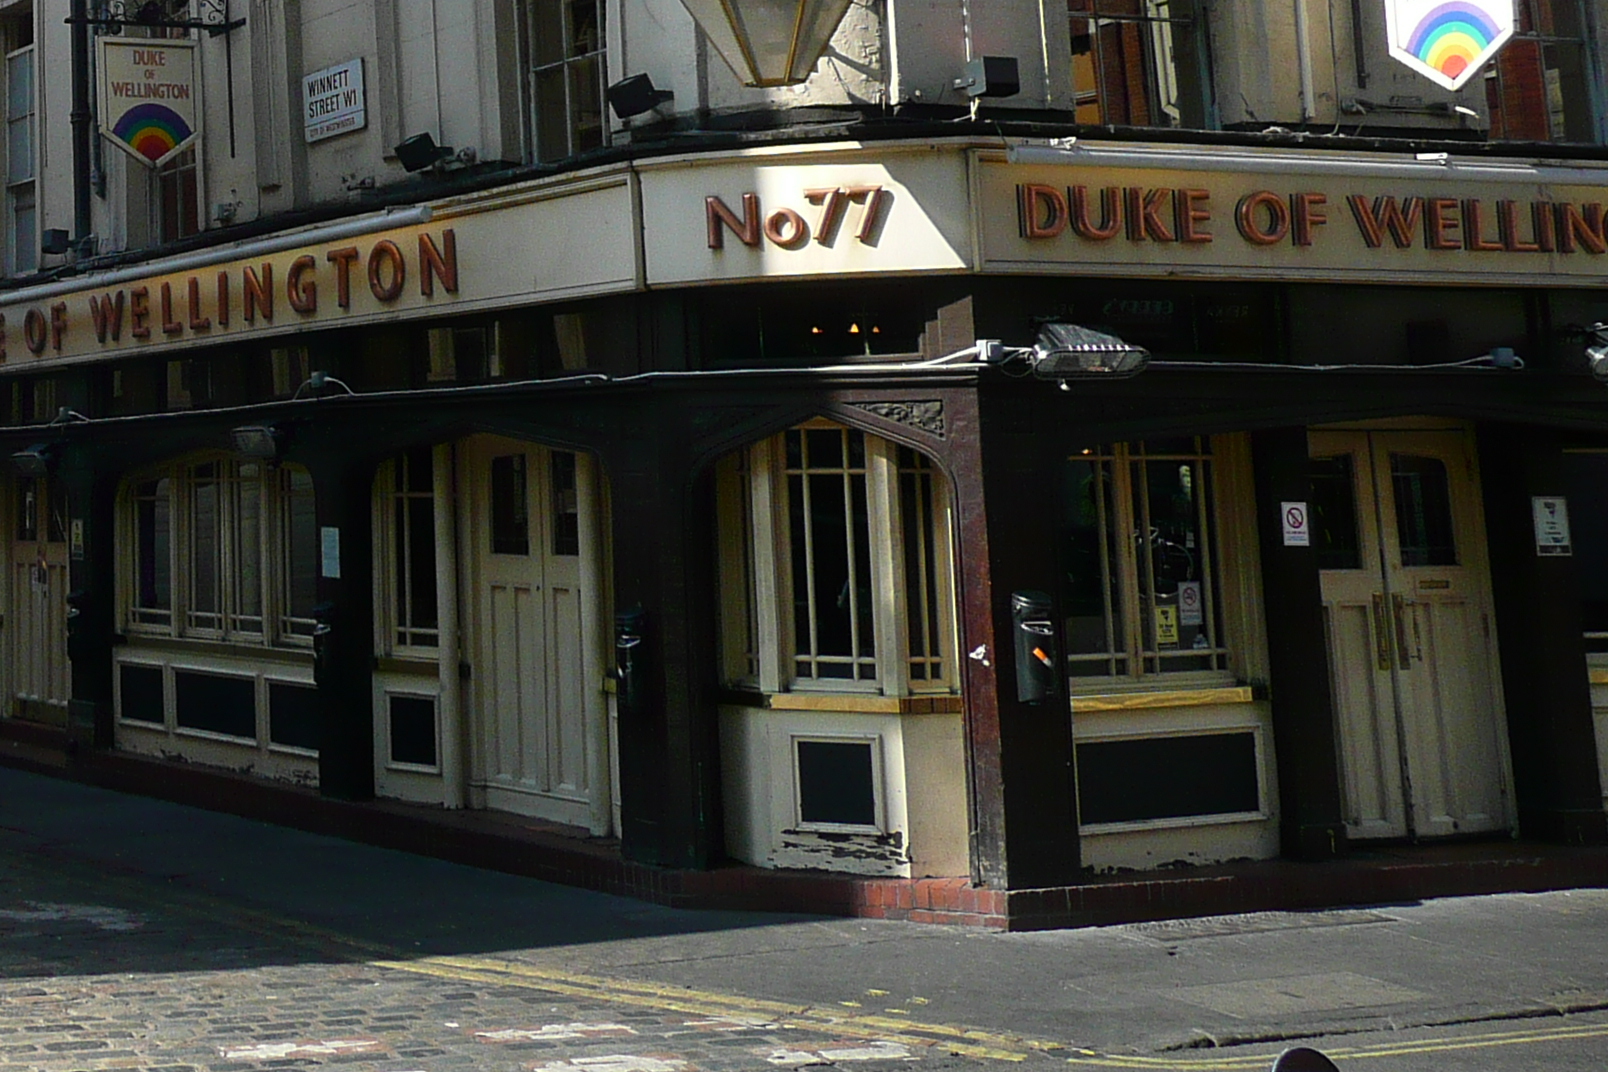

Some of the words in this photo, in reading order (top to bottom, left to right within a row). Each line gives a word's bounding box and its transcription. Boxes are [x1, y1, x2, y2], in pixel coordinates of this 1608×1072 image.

[132, 49, 166, 67] DUKE
[144, 69, 156, 80] OF
[308, 71, 349, 98] WINNETT
[111, 81, 190, 100] WELLINGTON
[309, 95, 340, 118] STREET
[344, 89, 357, 107] W1
[704, 184, 895, 250] No77
[1016, 183, 1214, 245] DUKE
[1234, 189, 1330, 248] OF
[1345, 192, 1608, 255] WELLIN
[23, 301, 68, 355] OF
[88, 227, 460, 345] WELLINGTON
